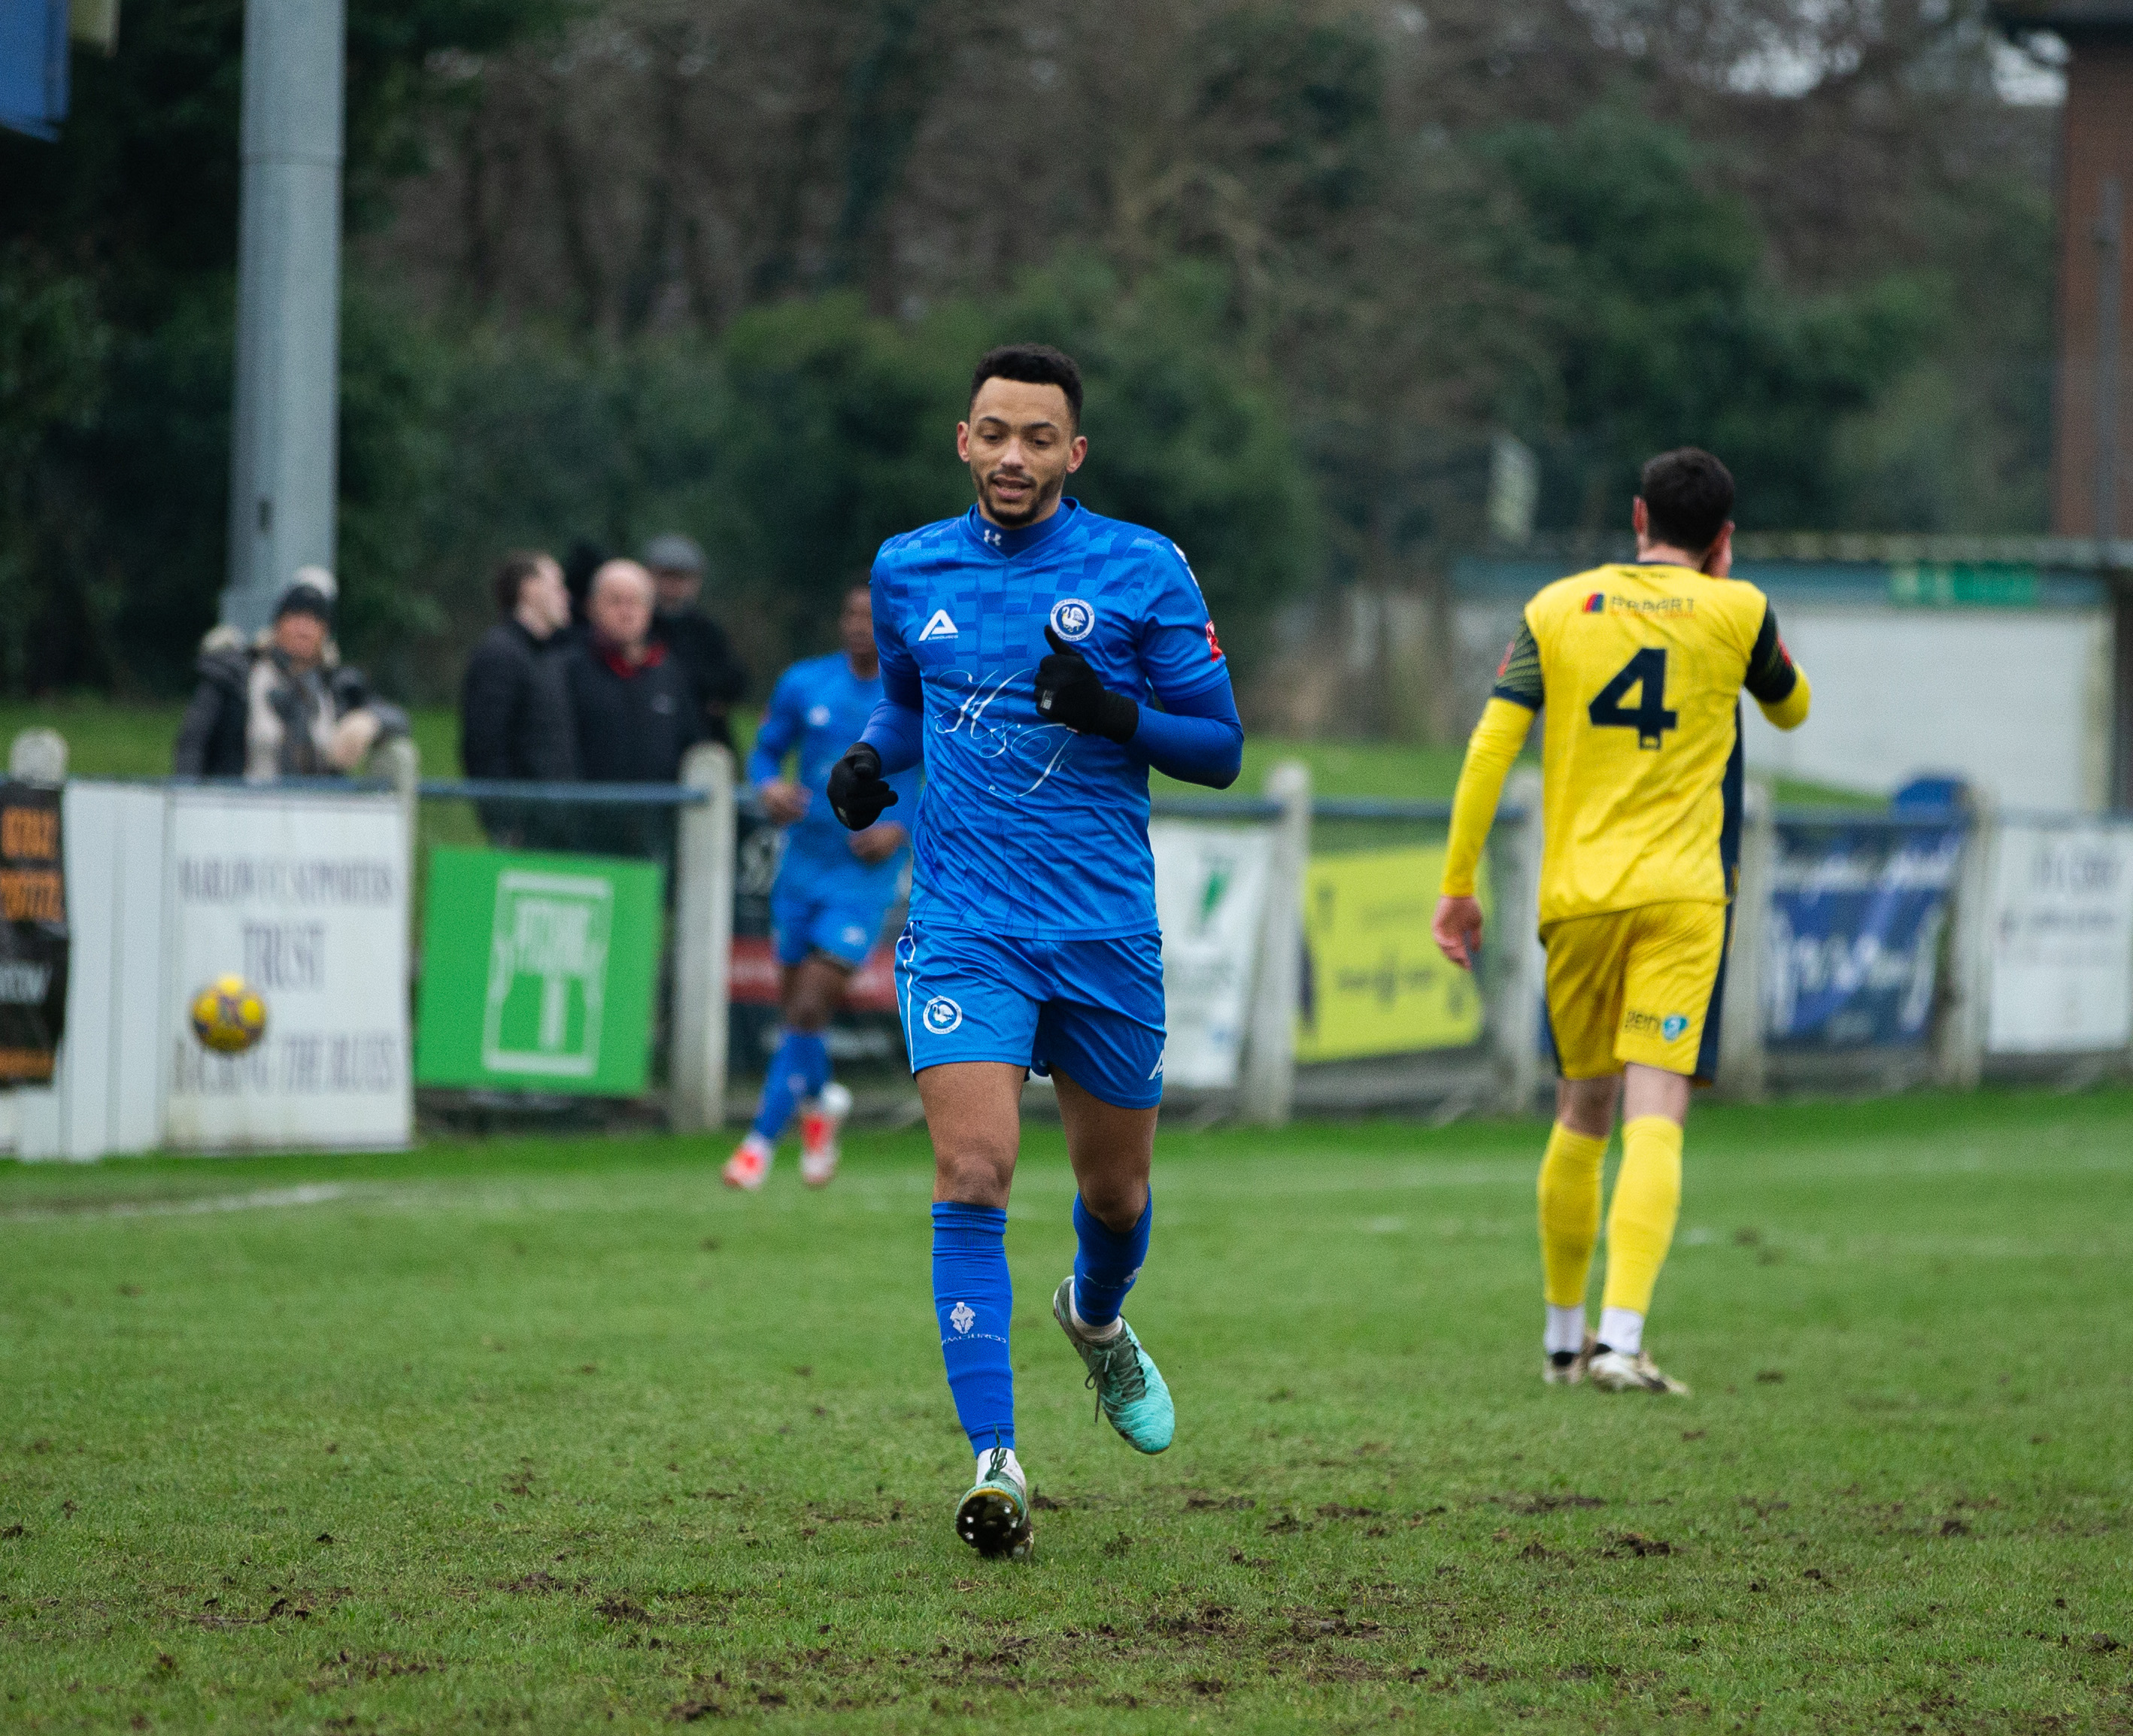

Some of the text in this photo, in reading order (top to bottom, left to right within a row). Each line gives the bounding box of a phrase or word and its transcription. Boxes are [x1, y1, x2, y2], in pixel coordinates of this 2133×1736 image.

[1588, 648, 1677, 750] 4
[242, 921, 325, 990] TRUST
[941, 1334, 1006, 1346] RMOURCO
